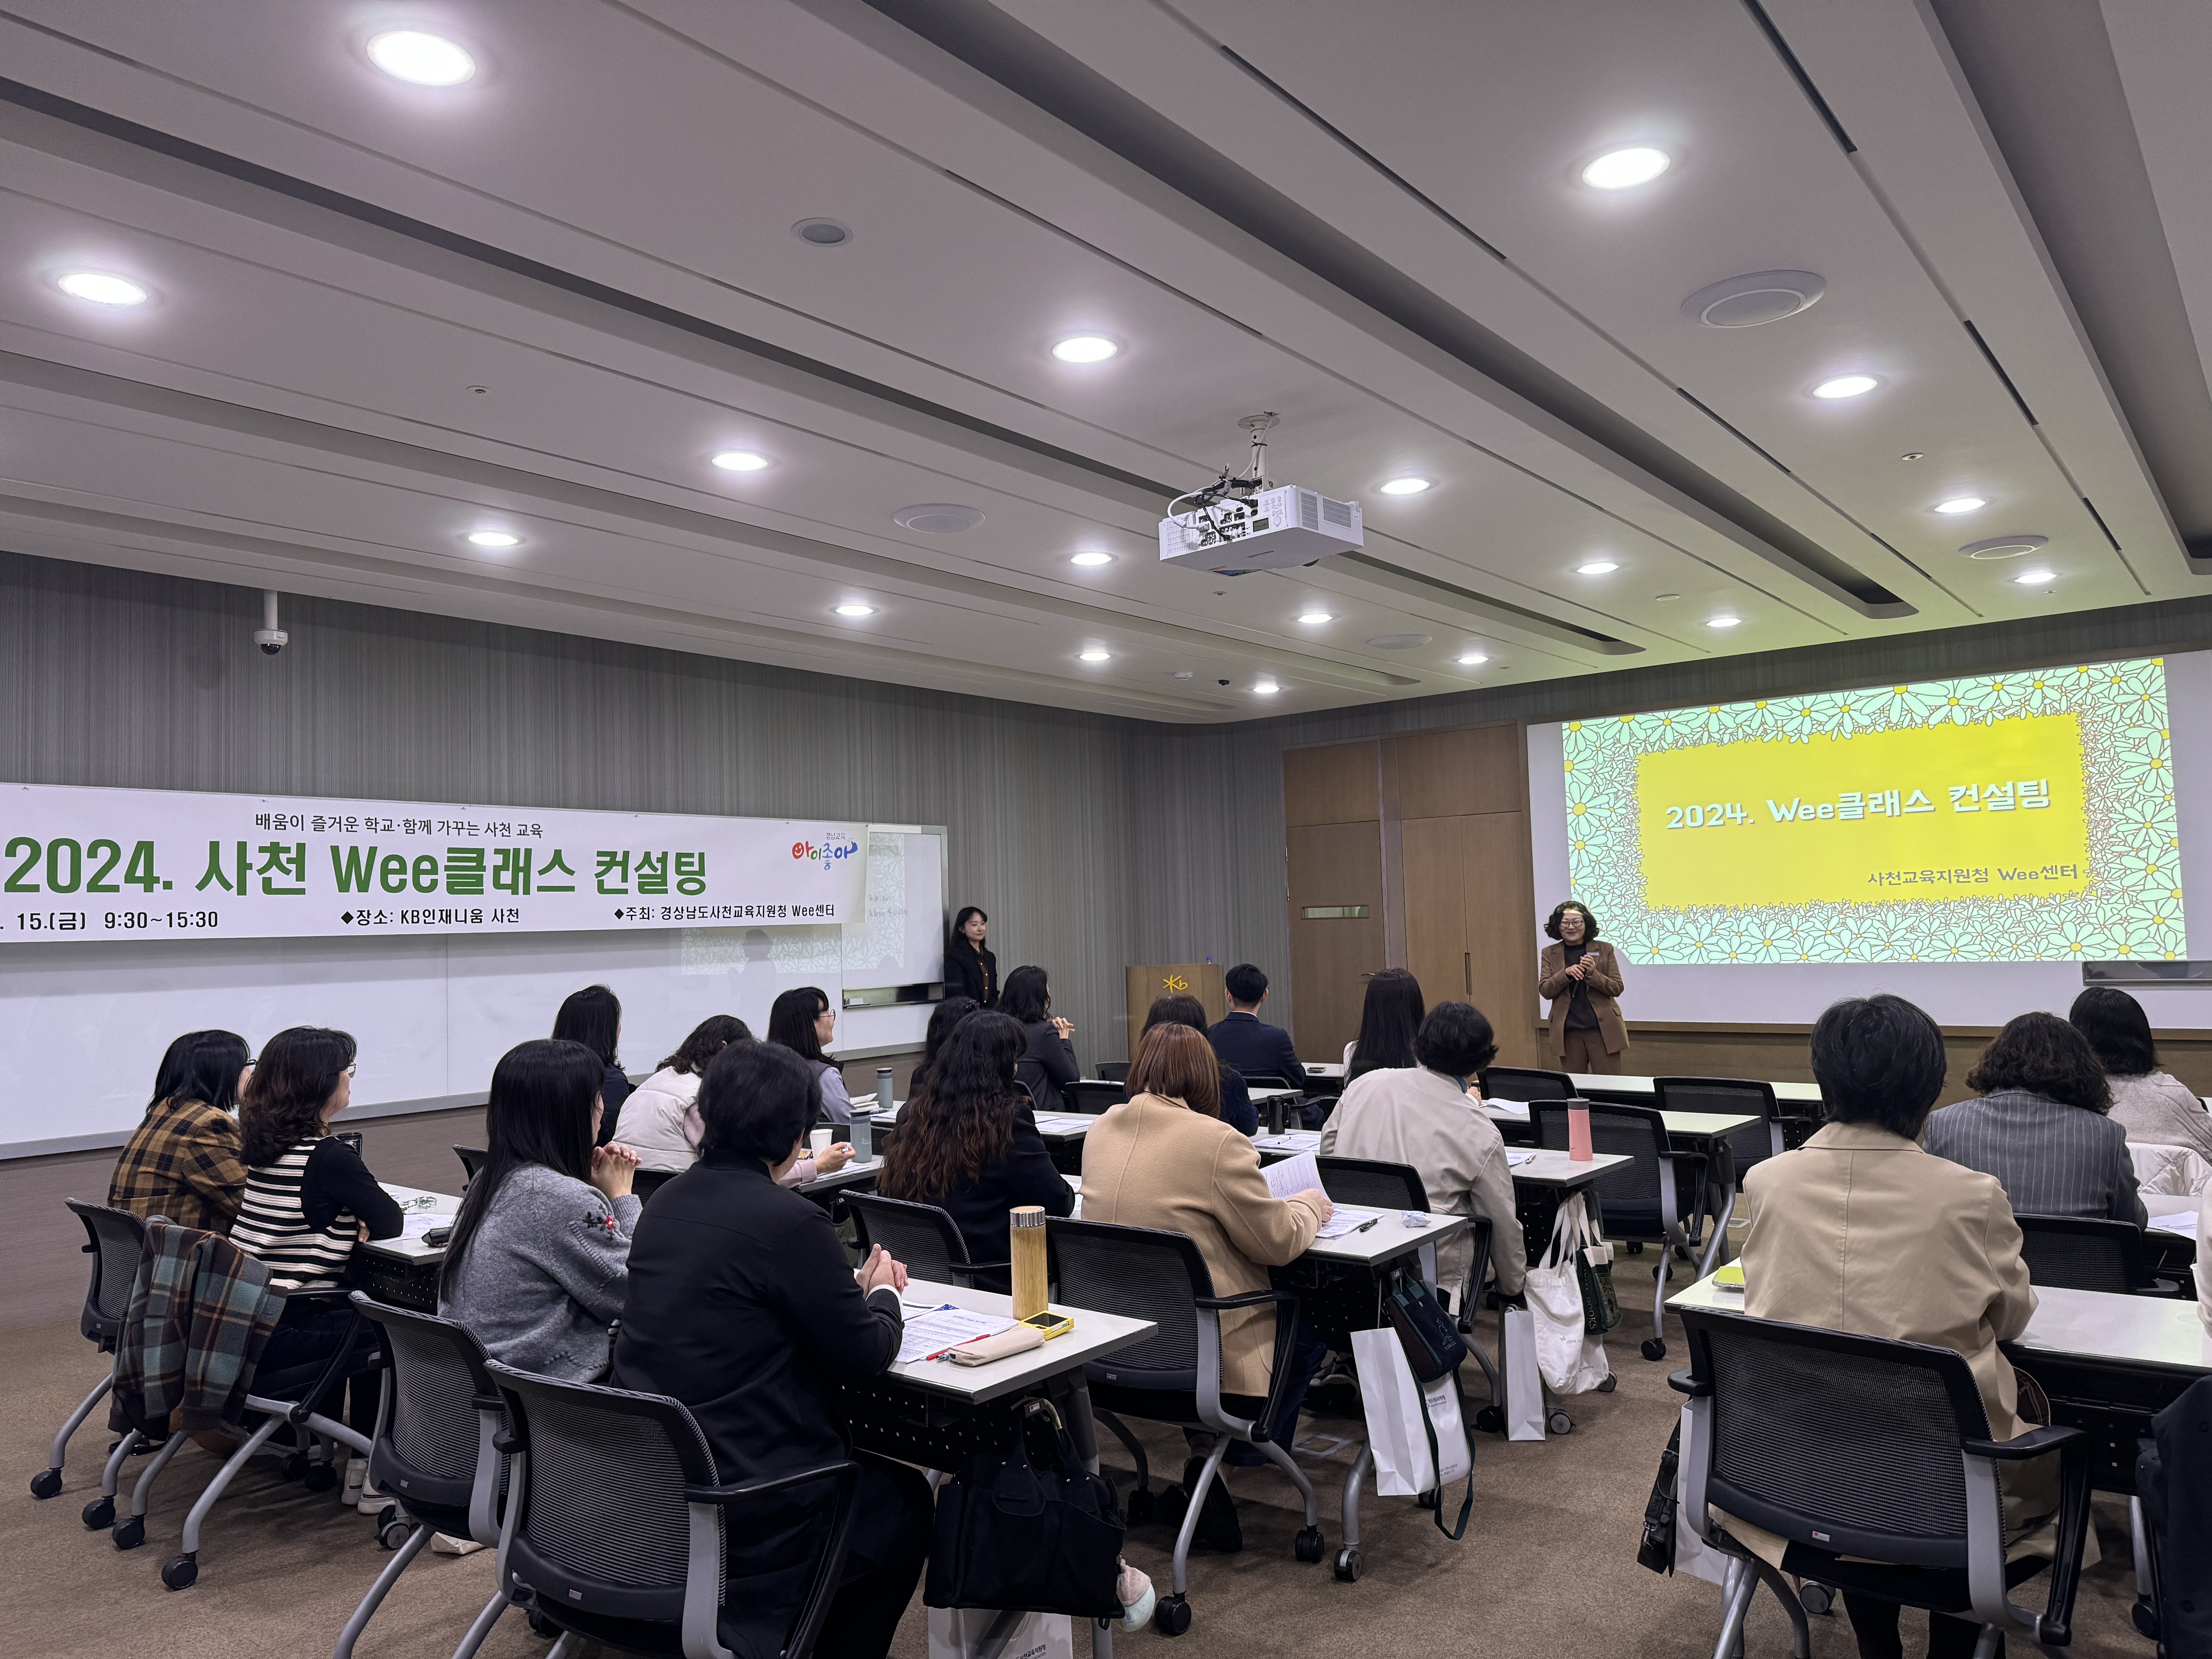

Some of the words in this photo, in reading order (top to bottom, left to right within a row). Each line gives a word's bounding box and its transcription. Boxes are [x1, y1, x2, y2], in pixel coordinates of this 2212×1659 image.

[1666, 803, 1755, 830] 2024.
[1767, 789, 1935, 823] Wee클래스
[1949, 779, 2050, 813] 컨설팅
[256, 813, 304, 832] 배움이
[311, 815, 360, 833] 즐거운
[437, 820, 481, 837] 가꾸는
[484, 822, 512, 838] 사천
[516, 823, 543, 839] 교육
[4, 836, 173, 894] 2024.
[195, 841, 307, 896] 사천
[330, 845, 576, 896] Wee클래스
[594, 851, 707, 896] 컨설팅
[792, 841, 858, 871] 아이좋아
[1868, 867, 1989, 887] 사천교육지원청
[1997, 864, 2078, 881] Wee센터
[105, 911, 218, 930] 9:30~15:30
[401, 909, 484, 925] KB인재니움
[491, 908, 520, 924] 사천
[661, 905, 787, 921] 경상남도사천교육지원청
[792, 904, 835, 918] Wee센터
